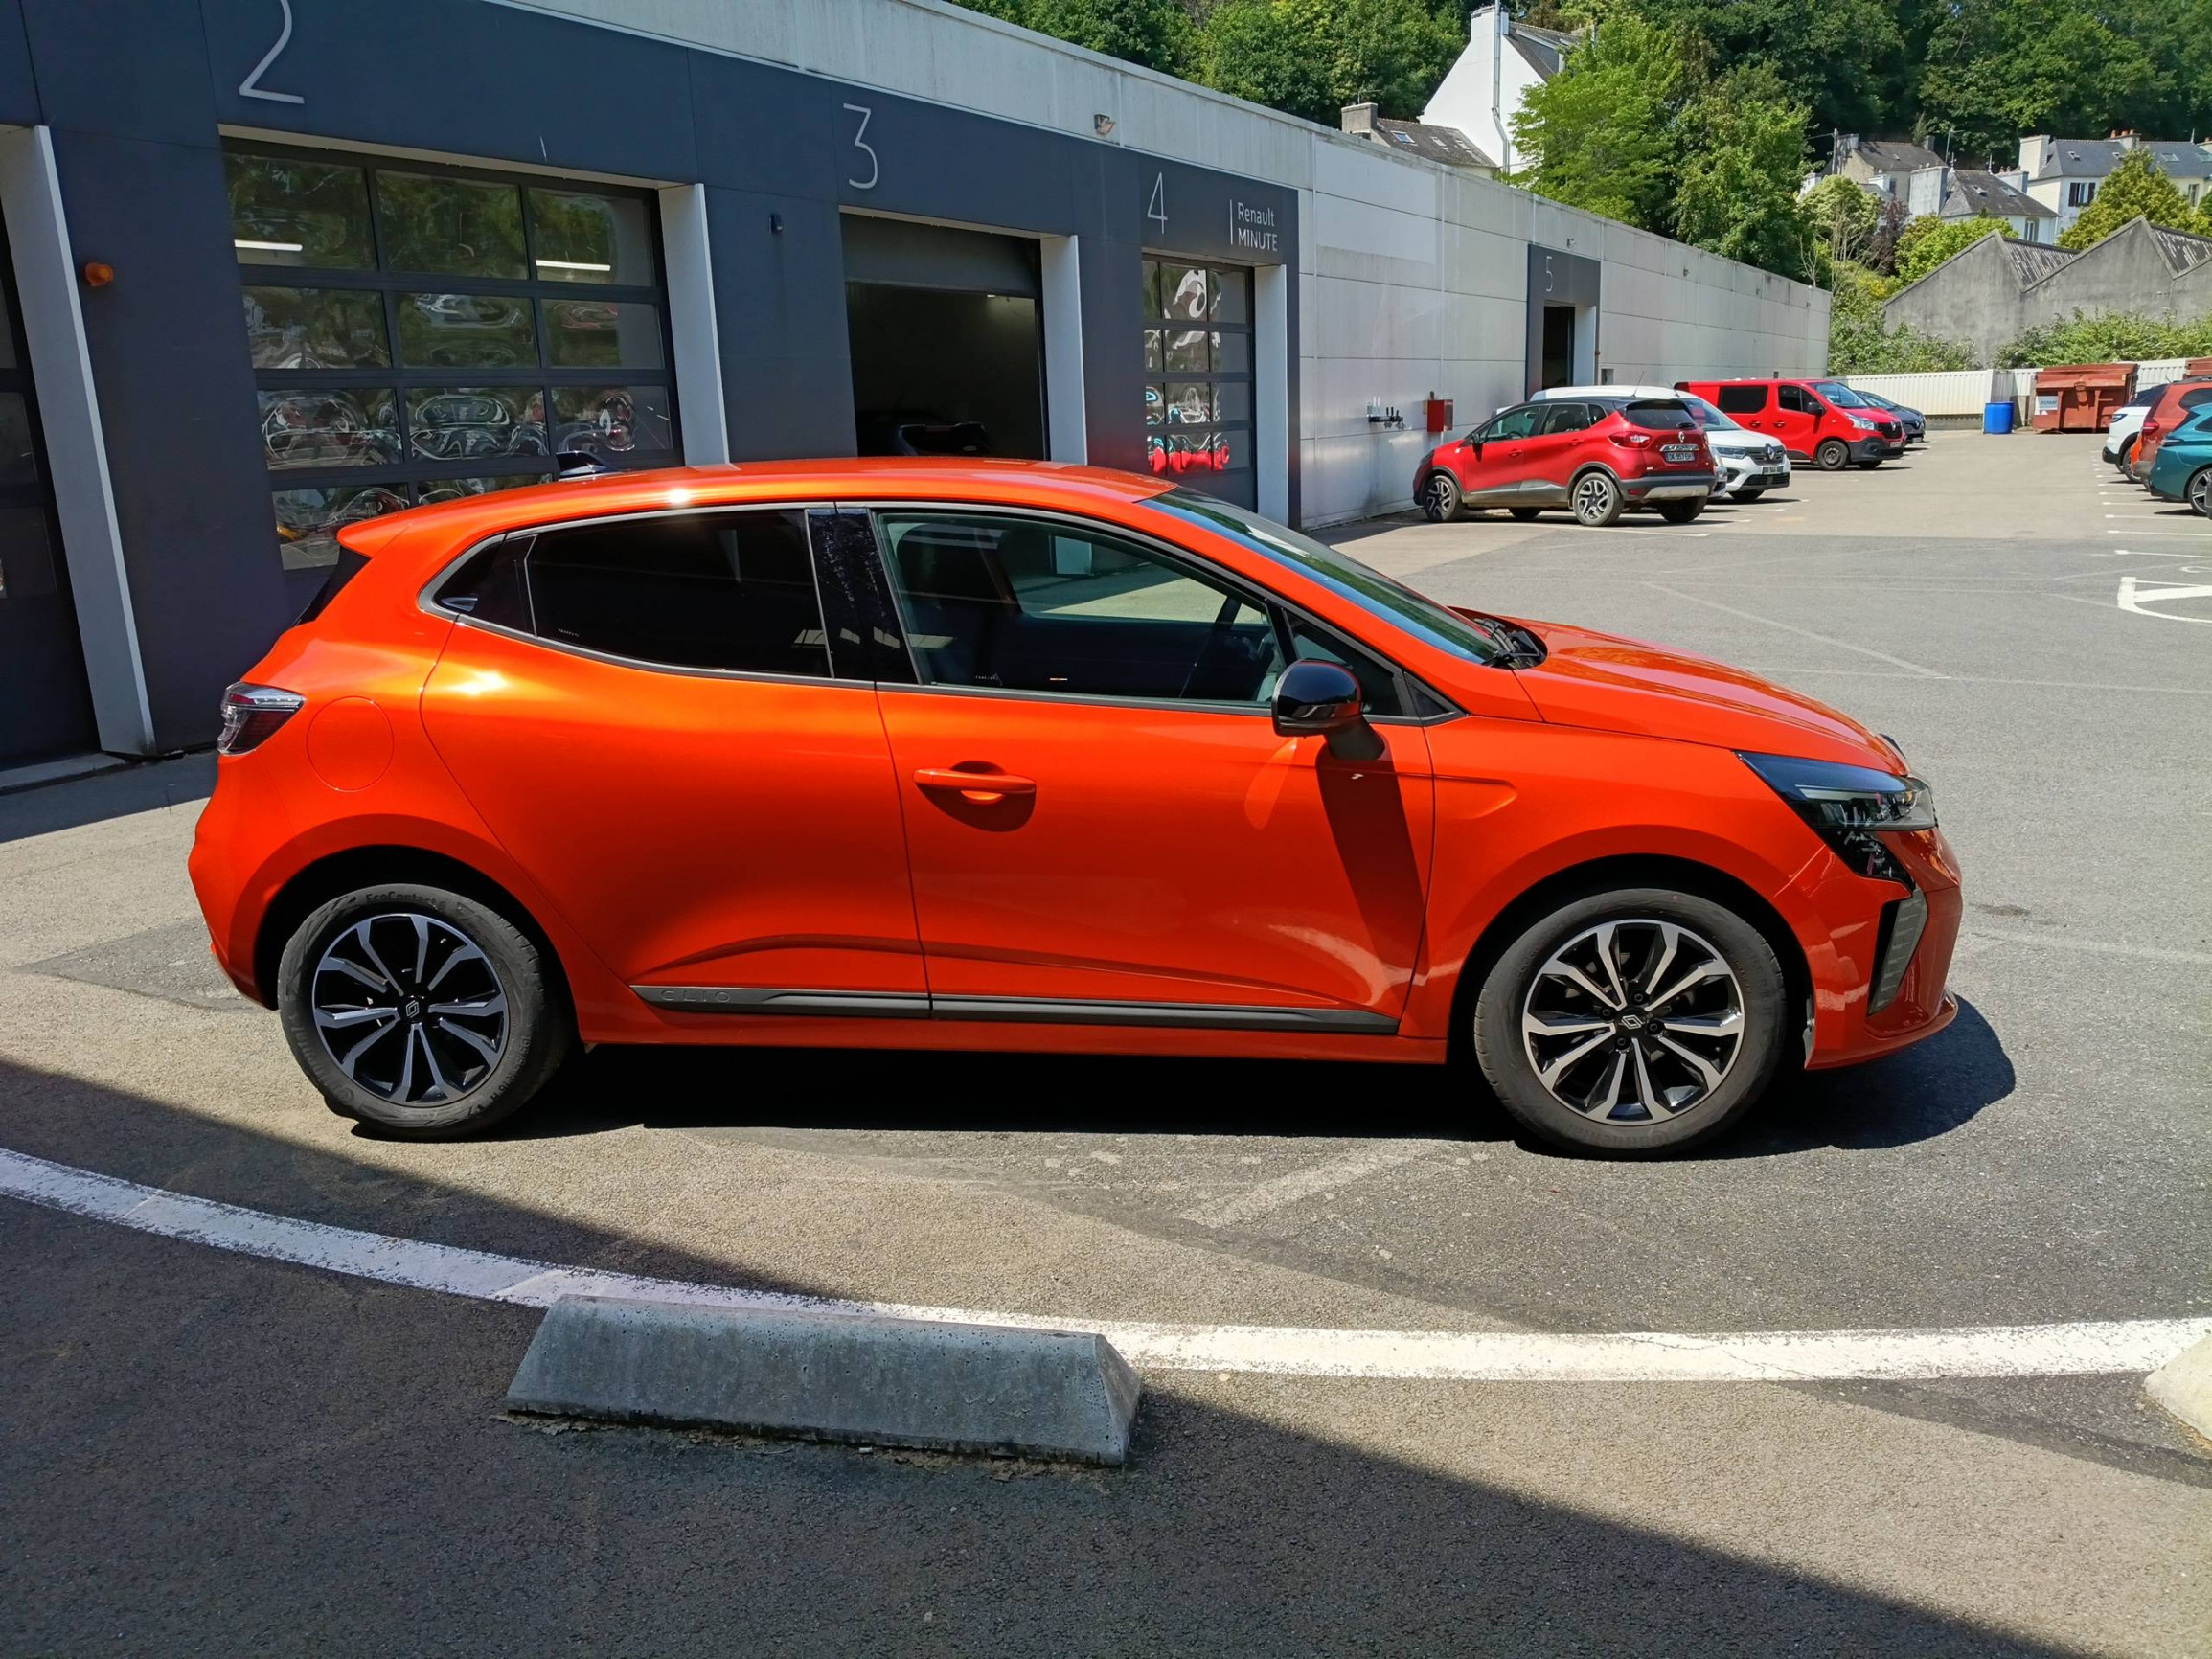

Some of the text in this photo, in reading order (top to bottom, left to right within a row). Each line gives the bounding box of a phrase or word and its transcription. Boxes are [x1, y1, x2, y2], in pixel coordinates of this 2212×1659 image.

[239, 0, 305, 104] 2
[843, 102, 878, 189] 3
[1148, 171, 1168, 234] 4
[1238, 202, 1275, 227] Renault
[1238, 227, 1278, 252] MINUTE
[1545, 255, 1554, 292] 5
[660, 989, 731, 1003] CLIO
